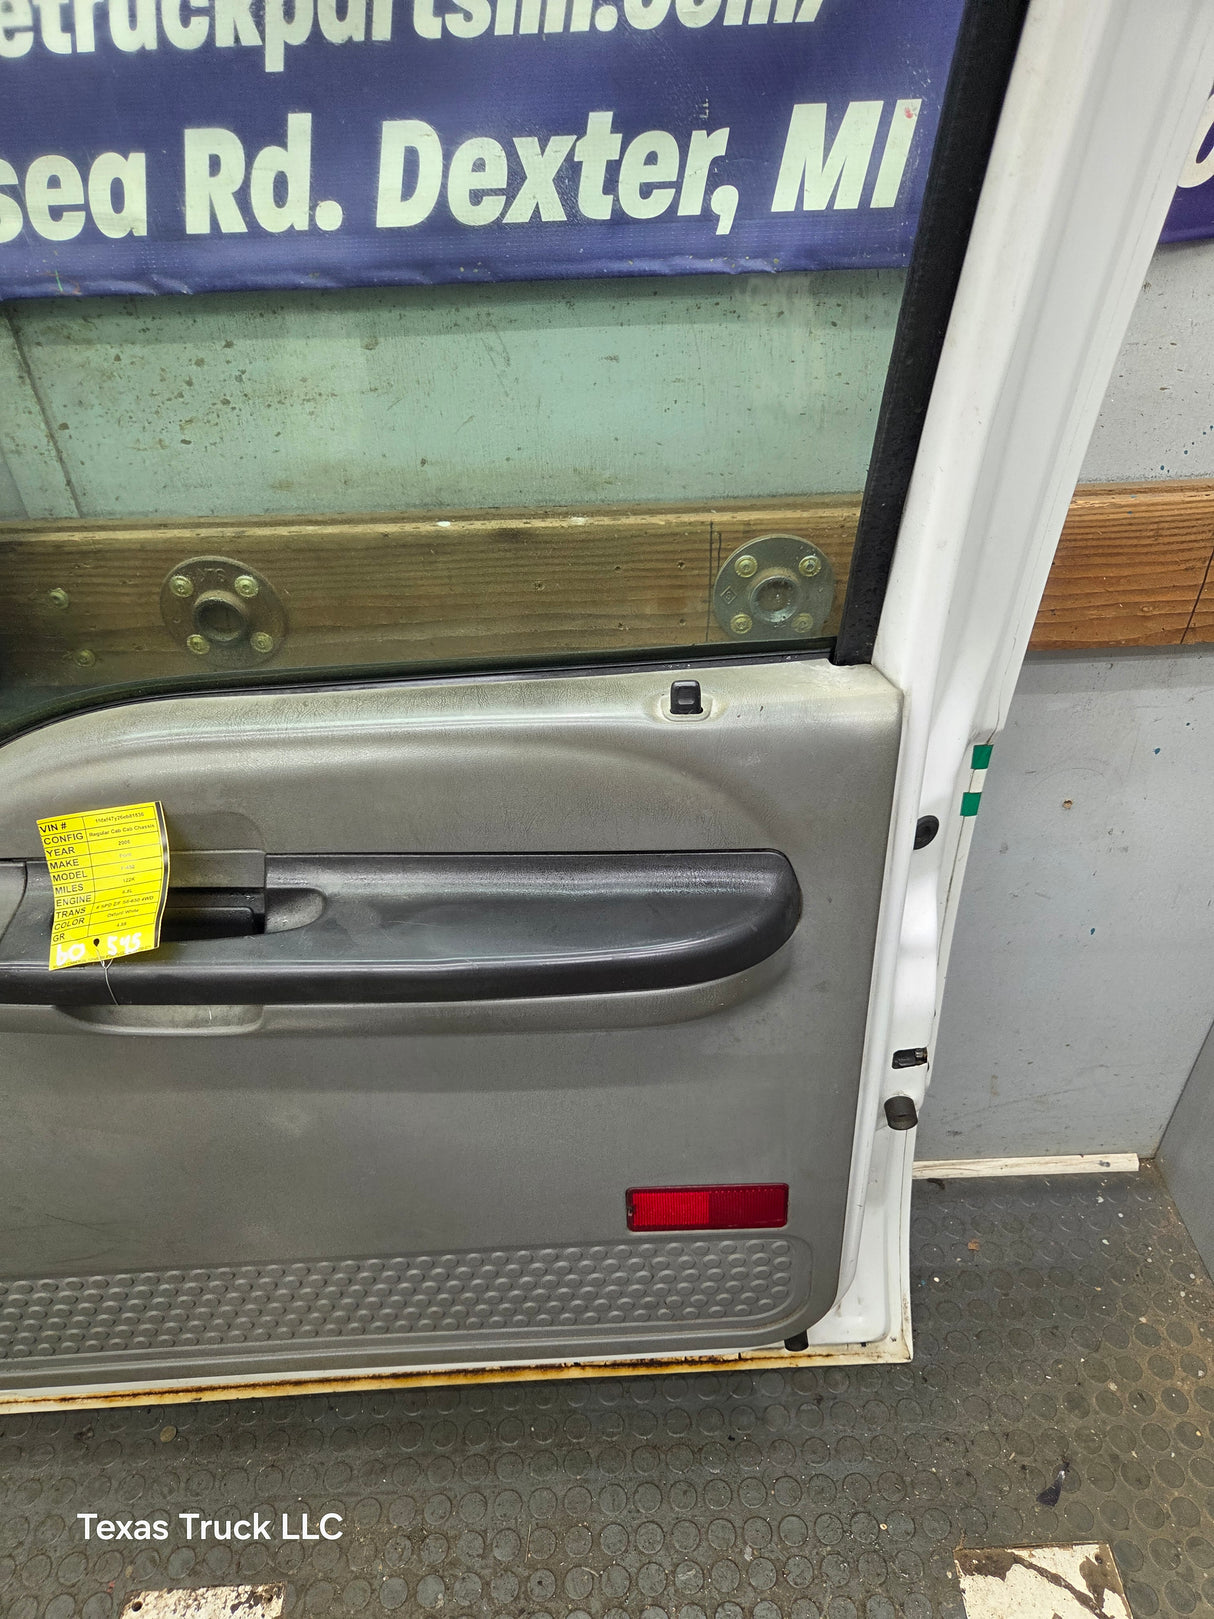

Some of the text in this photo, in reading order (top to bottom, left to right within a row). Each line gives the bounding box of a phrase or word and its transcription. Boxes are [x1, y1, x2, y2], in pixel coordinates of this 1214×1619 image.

[0, 0, 823, 73] etruckpars.
[184, 113, 344, 235] Rd.
[376, 111, 739, 235] Dexter,
[771, 99, 922, 212] MI
[40, 824, 58, 833] VIN
[61, 822, 66, 830] #
[44, 833, 83, 845] CONFIG
[46, 847, 75, 857] YEAR
[50, 859, 79, 870] MAKE
[53, 870, 88, 882] MODEL
[55, 883, 84, 895] MILES
[56, 895, 92, 907] ENGINE
[56, 907, 86, 919] TRANS
[54, 917, 85, 930] COLOR
[53, 932, 65, 942] GR
[107, 932, 142, 956] 545
